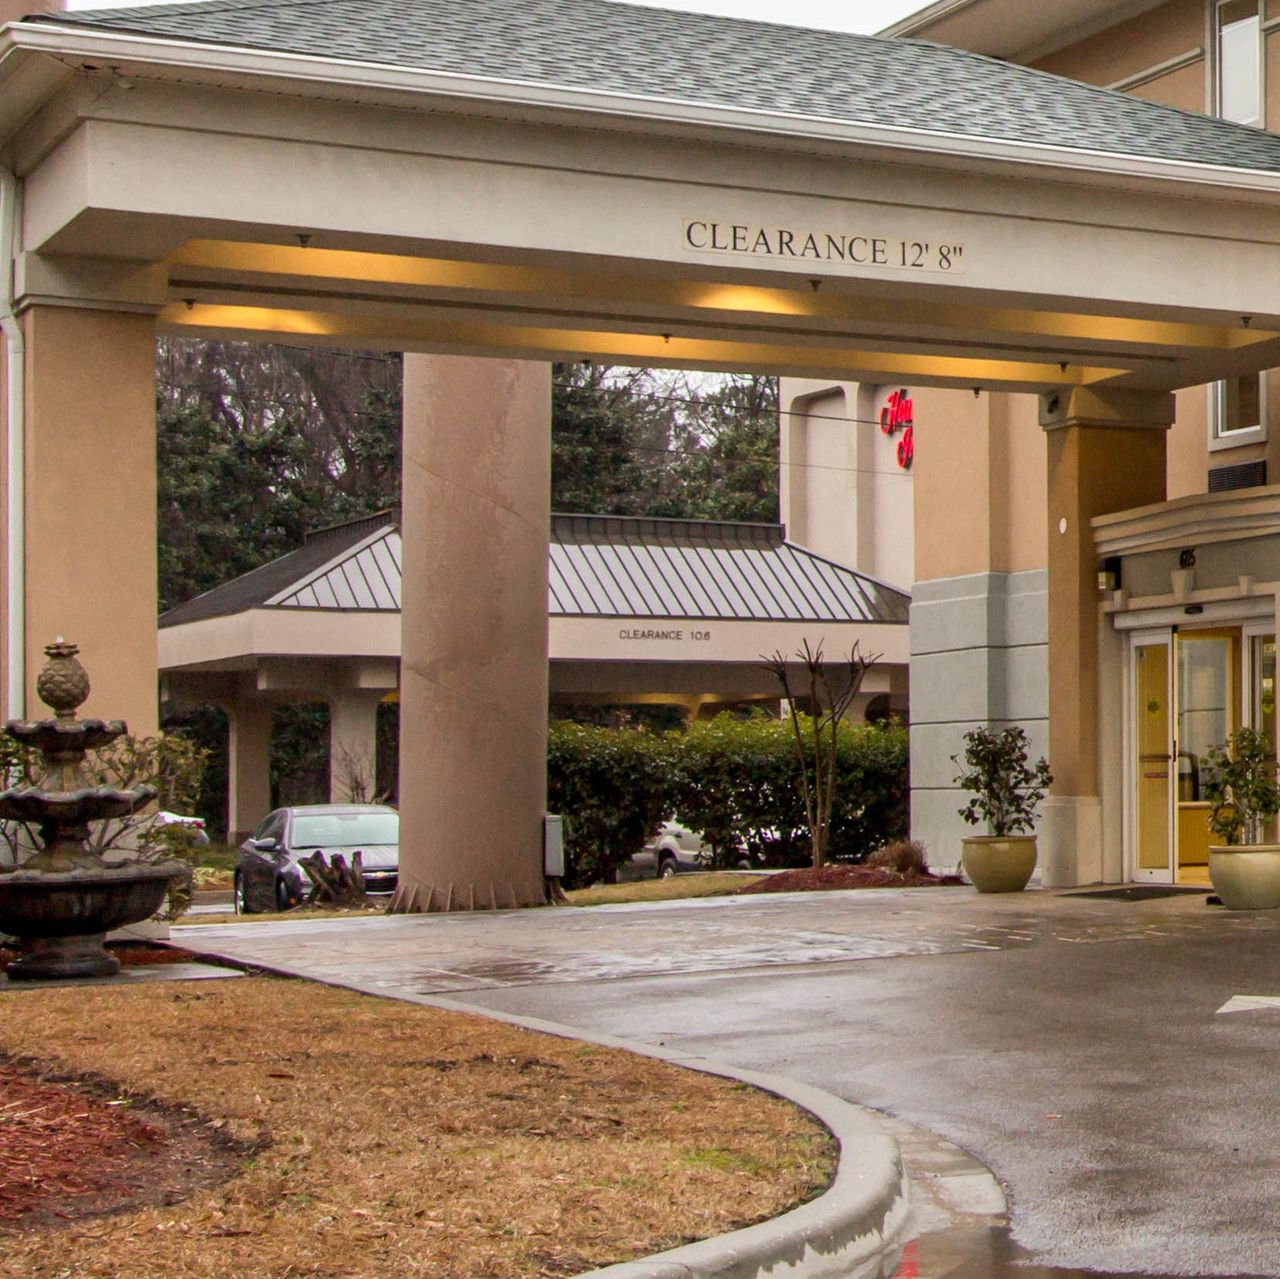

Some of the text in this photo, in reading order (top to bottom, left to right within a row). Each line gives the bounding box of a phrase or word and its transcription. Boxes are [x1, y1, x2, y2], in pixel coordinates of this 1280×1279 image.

[686, 221, 963, 271] CLEARANCE 12' 8"
[619, 629, 683, 640] CLEARANCE
